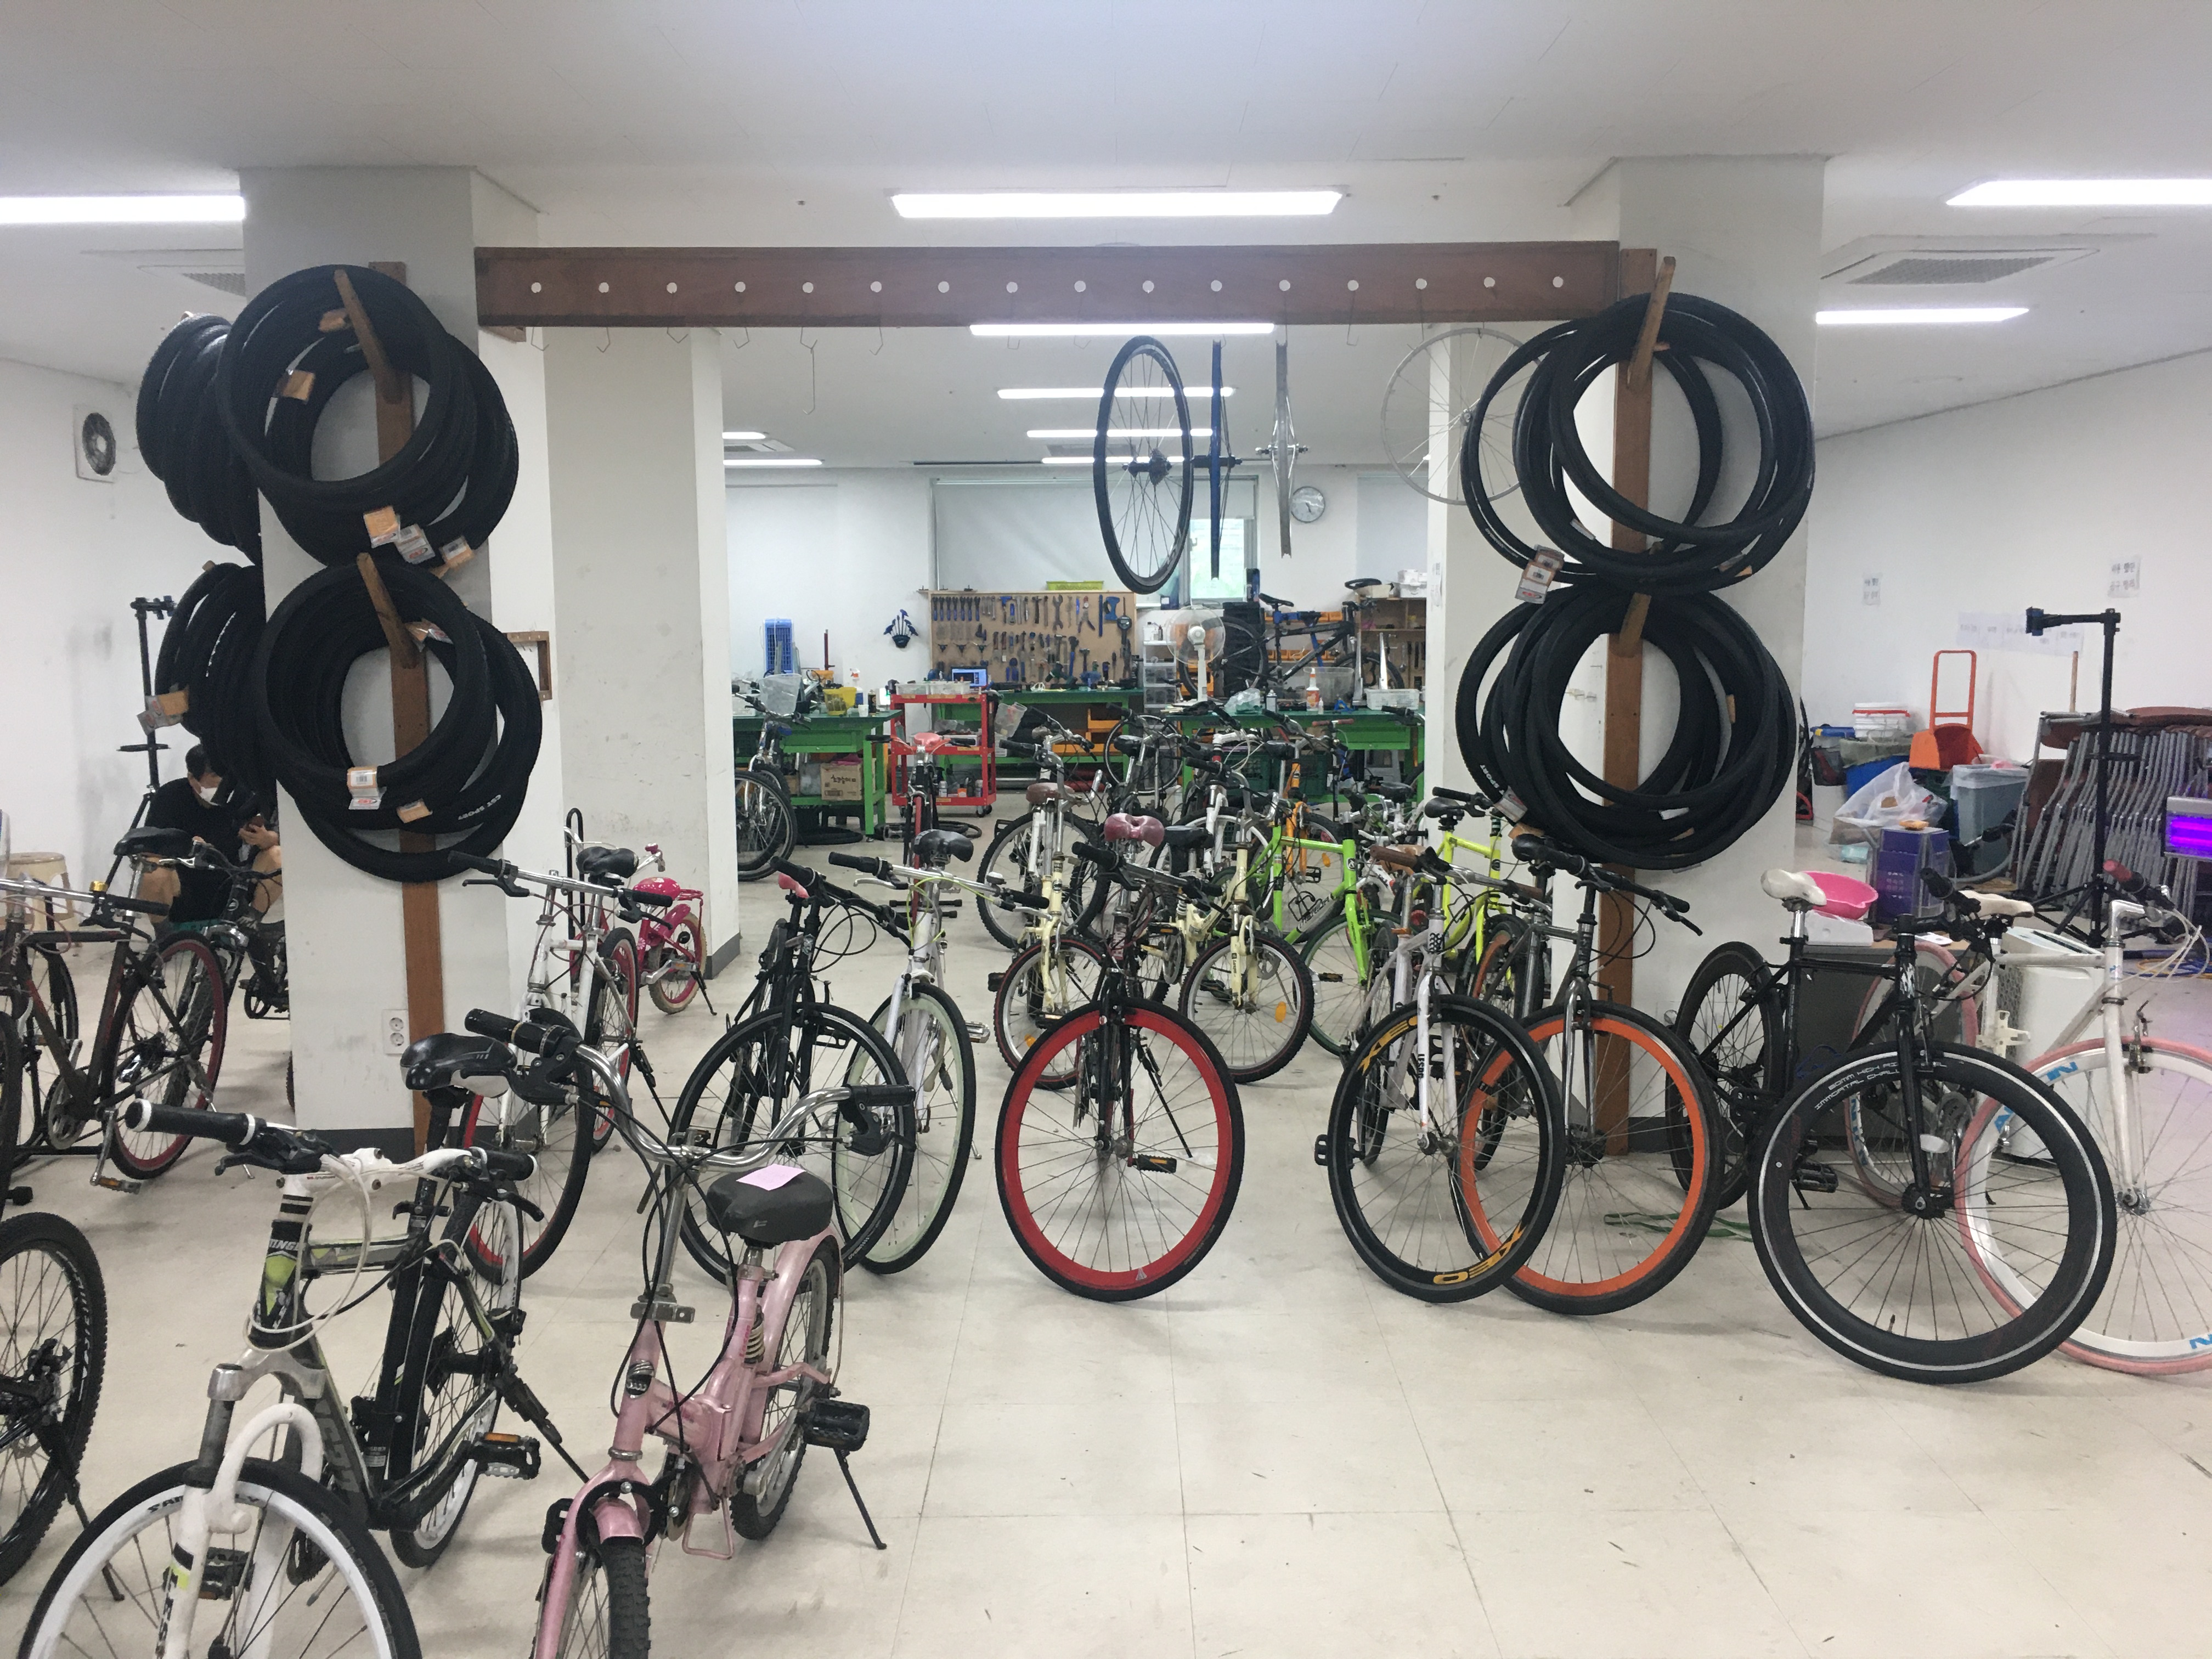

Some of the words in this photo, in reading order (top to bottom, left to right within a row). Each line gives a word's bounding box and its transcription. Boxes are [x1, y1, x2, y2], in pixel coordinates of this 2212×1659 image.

[1480, 765, 1499, 788] SPORT
[486, 794, 501, 807] CST
[458, 806, 485, 820] SPORT
[1814, 1080, 1864, 1110] IMMORTAL
